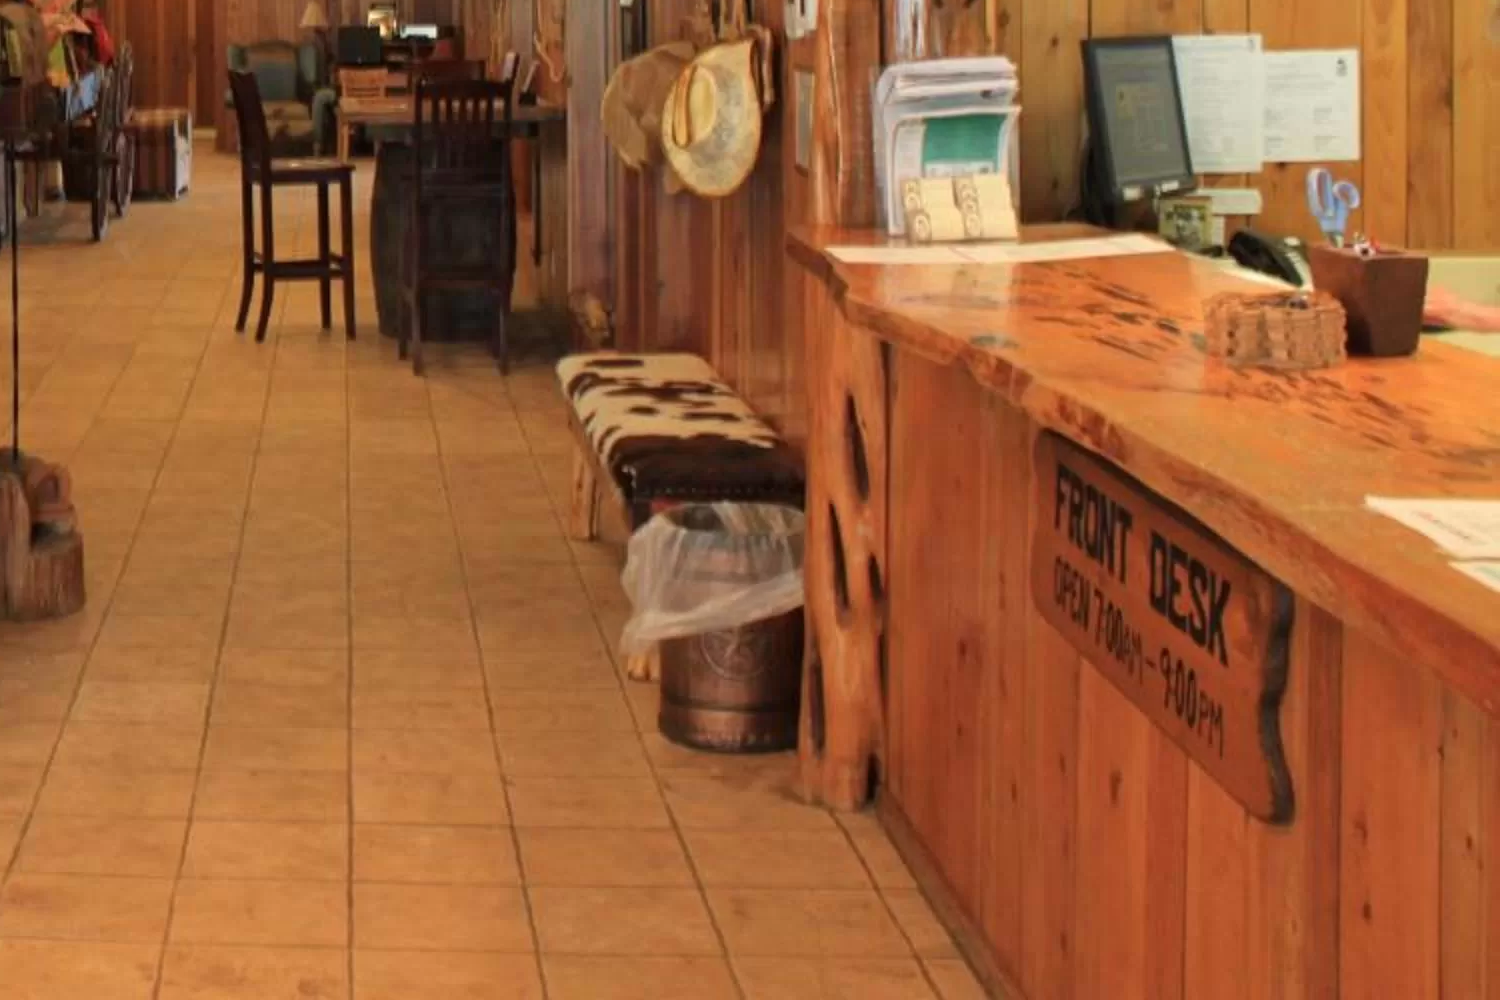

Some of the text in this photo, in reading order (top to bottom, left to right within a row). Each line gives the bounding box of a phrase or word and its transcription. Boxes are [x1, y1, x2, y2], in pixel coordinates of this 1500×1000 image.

[1055, 464, 1231, 668] FRONT DESK
[1055, 555, 1090, 632] OPEN
